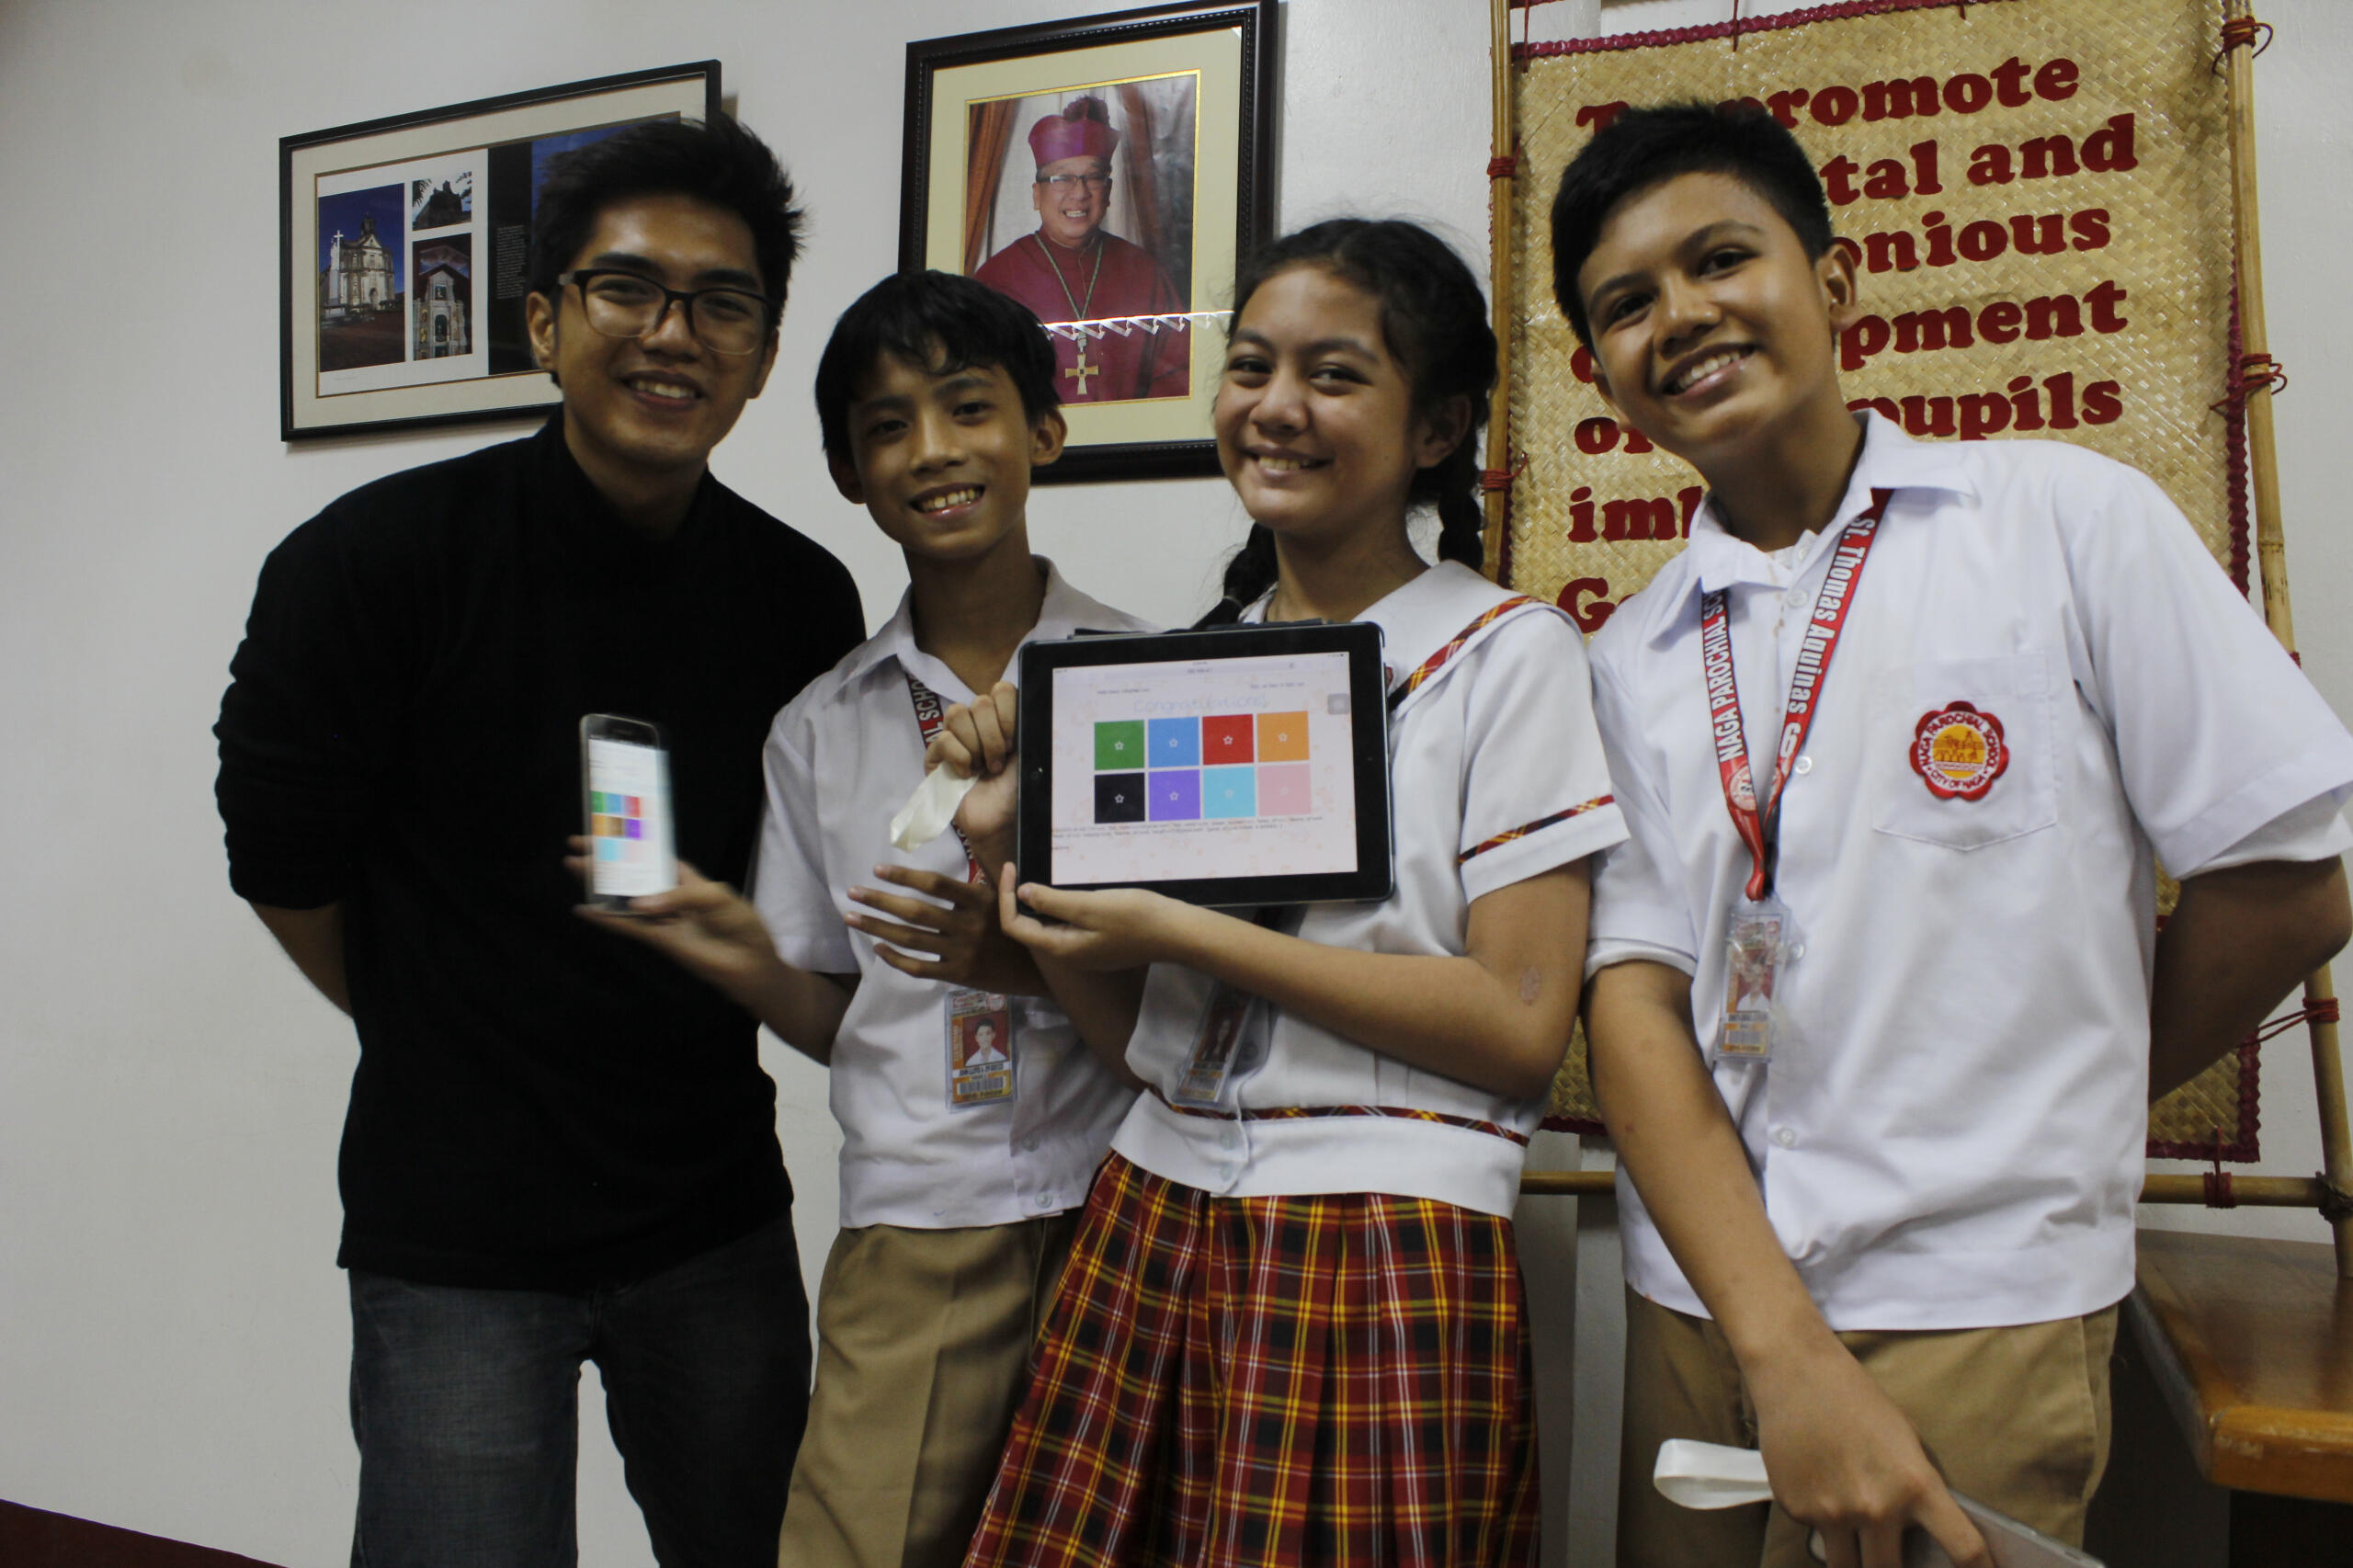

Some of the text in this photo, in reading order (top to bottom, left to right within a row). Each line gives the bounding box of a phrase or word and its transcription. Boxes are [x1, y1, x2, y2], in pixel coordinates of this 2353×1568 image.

[1967, 112, 2139, 187] and
[1840, 279, 2129, 371] pment
[1842, 517, 1876, 540] St.
[1813, 546, 1866, 622] Thomas
[1704, 615, 1736, 710] PAROCHIAL
[1788, 624, 1836, 714] Aquinas
[1714, 707, 1745, 763] NAGA
